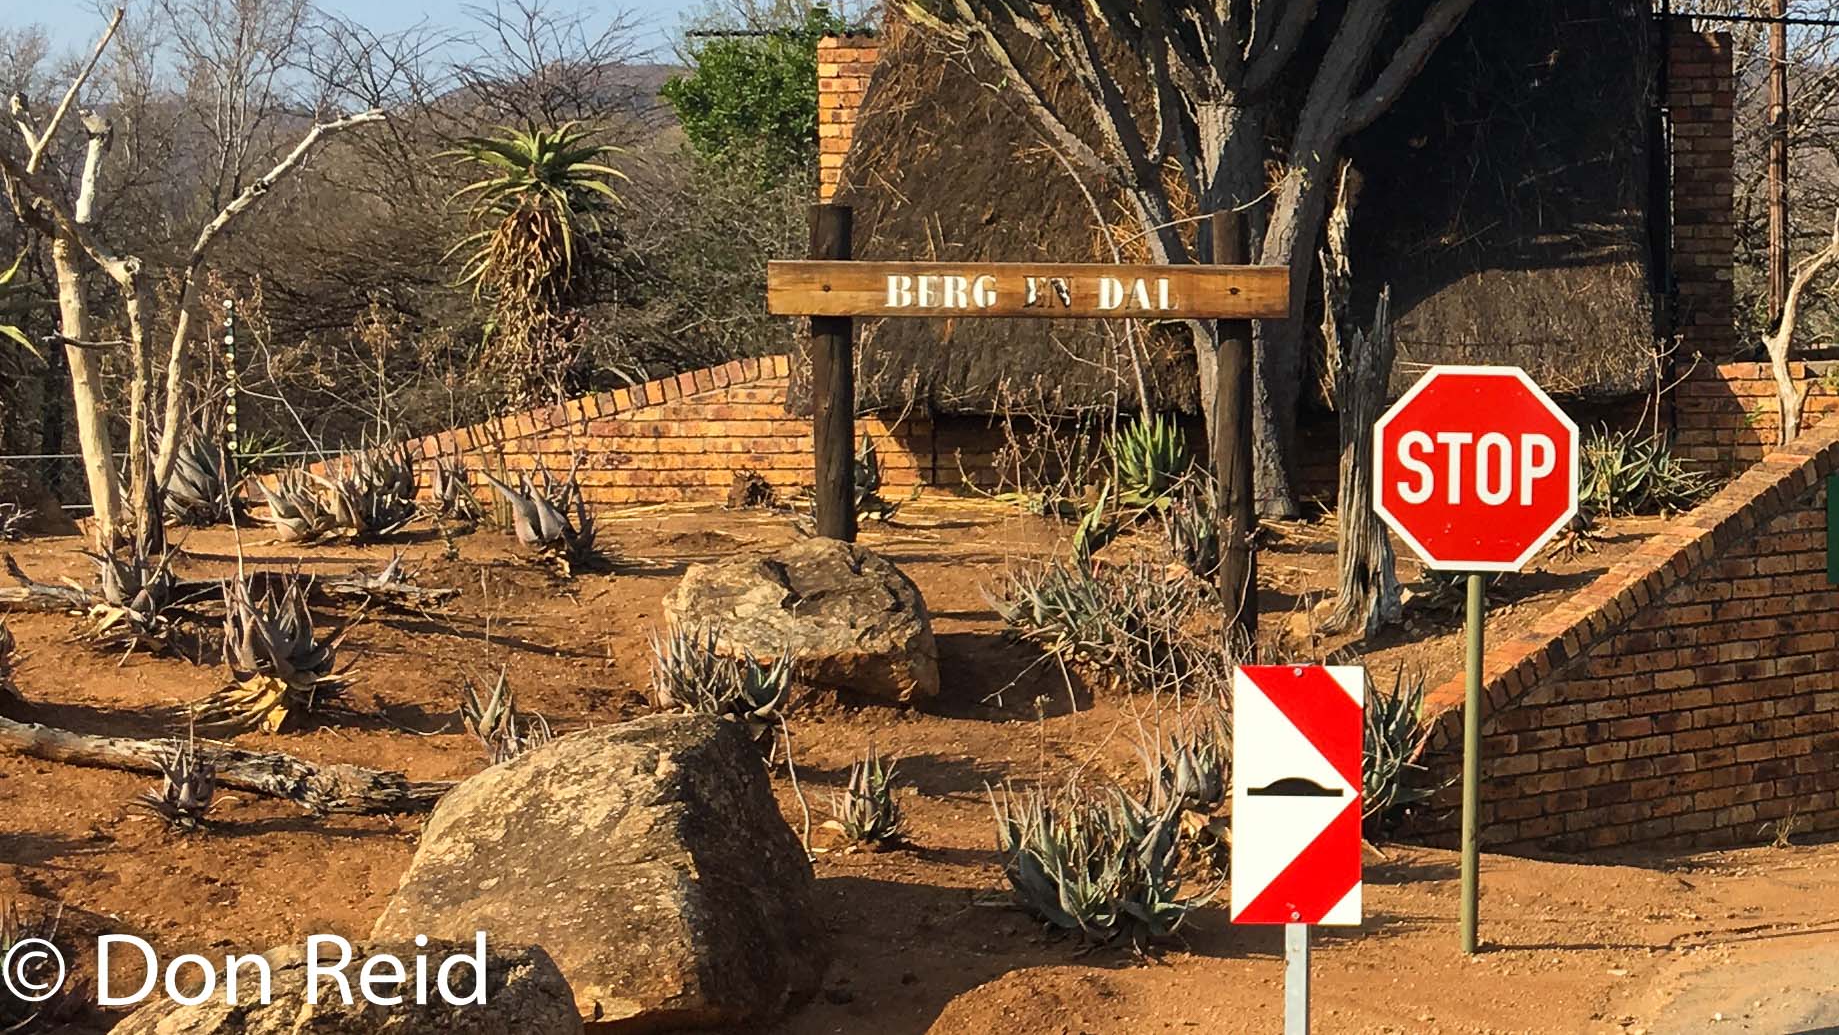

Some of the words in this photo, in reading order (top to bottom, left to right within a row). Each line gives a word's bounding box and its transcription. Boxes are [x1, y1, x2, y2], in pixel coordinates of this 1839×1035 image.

[884, 274, 997, 311] BERG
[1023, 276, 1074, 309] EN
[1098, 276, 1180, 311] DAL
[1397, 430, 1557, 507] STOP
